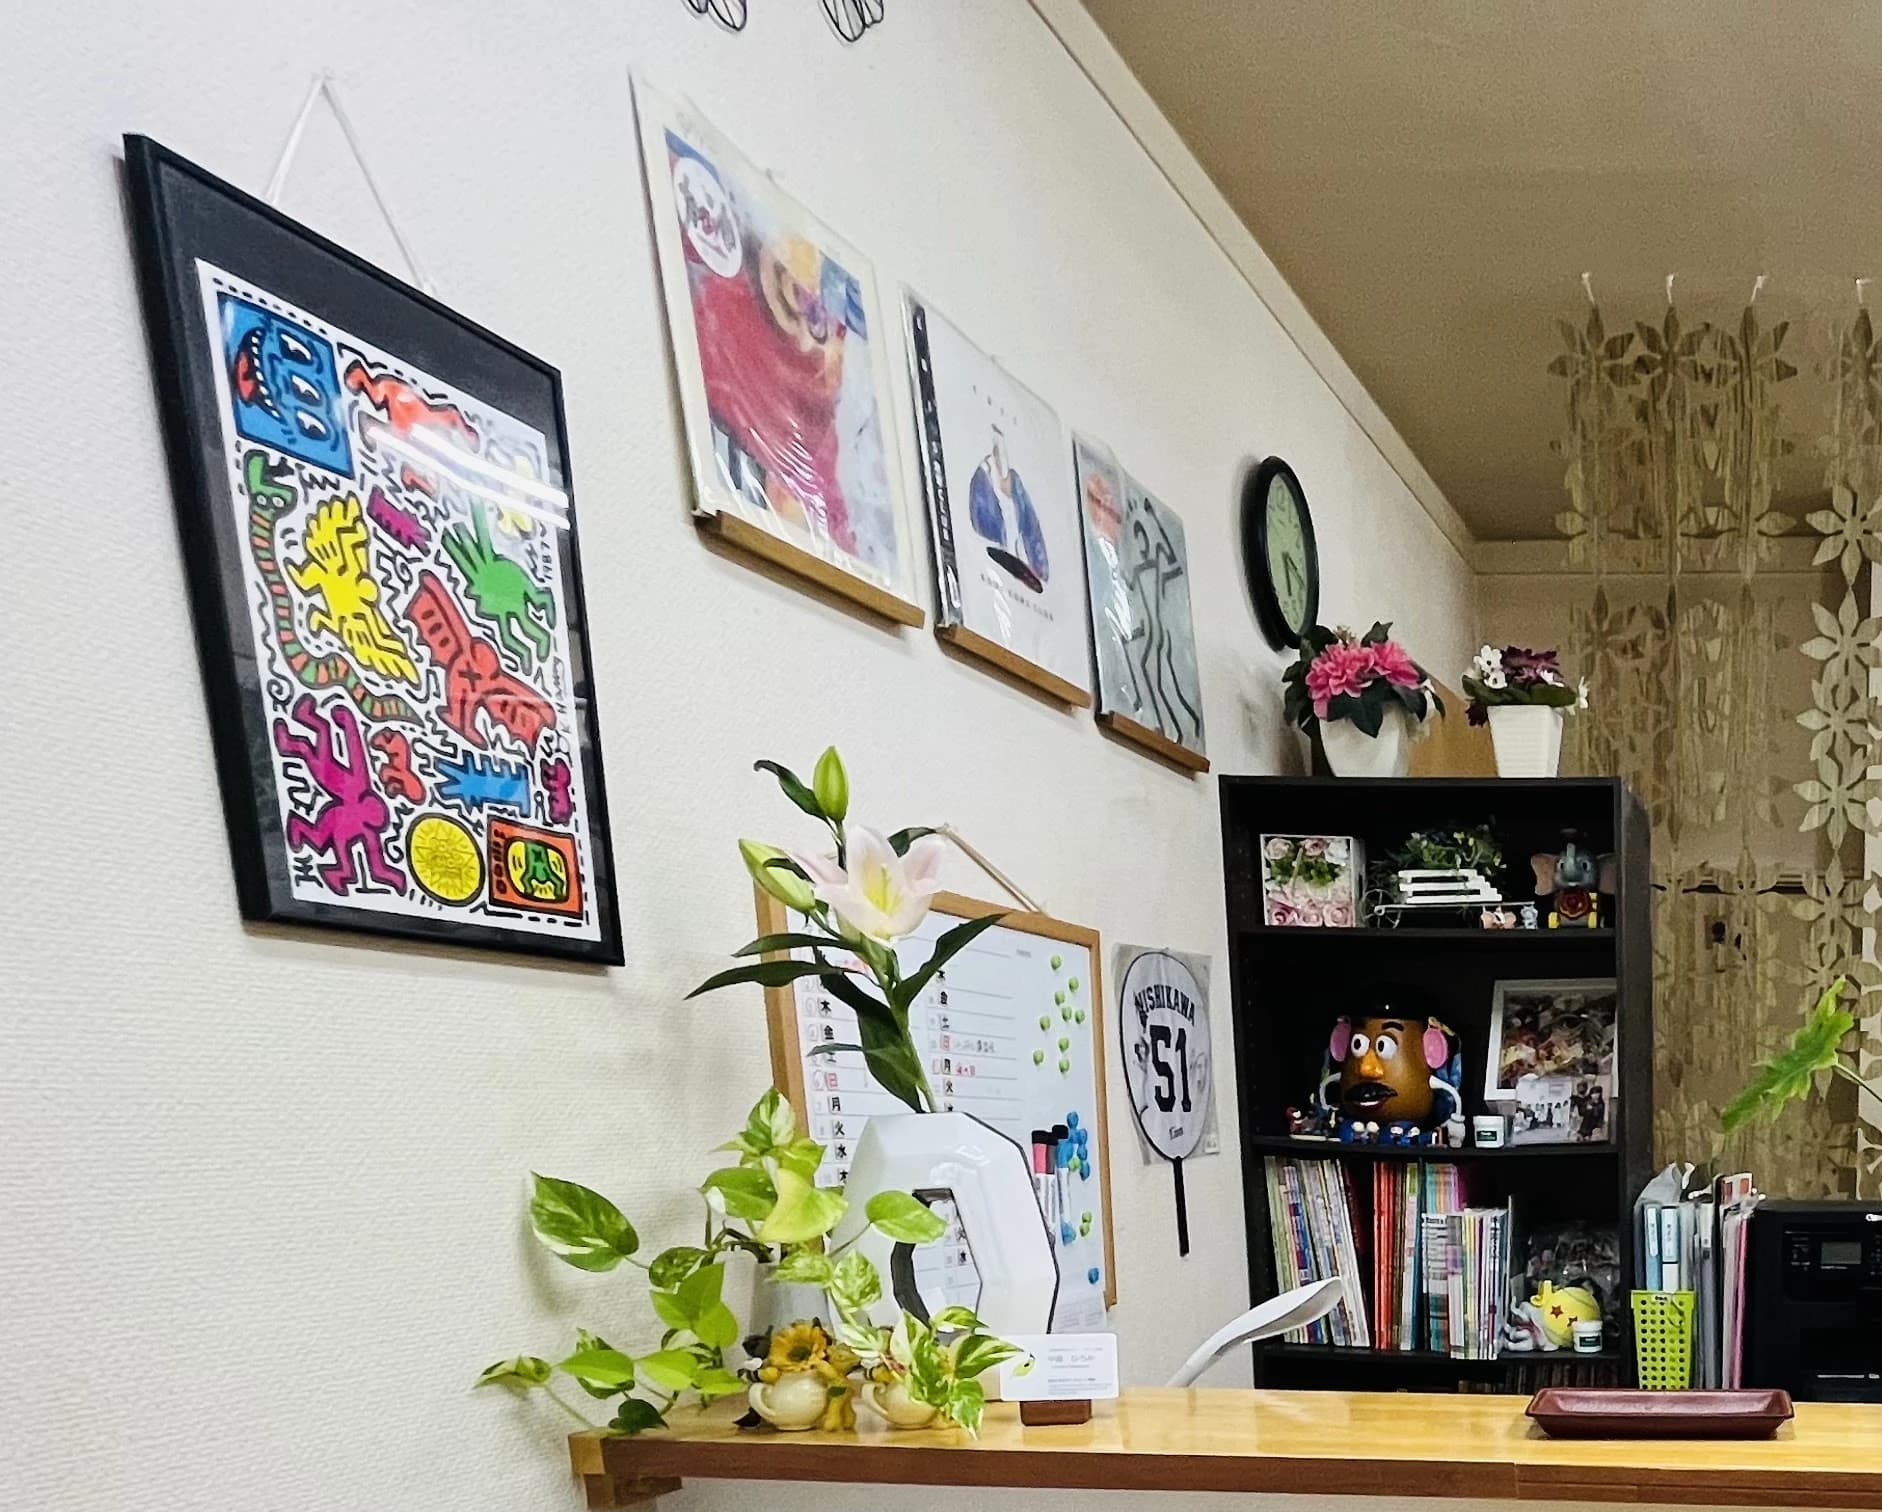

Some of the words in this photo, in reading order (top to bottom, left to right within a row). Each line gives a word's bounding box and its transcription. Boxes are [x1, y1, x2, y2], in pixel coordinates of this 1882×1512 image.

[1134, 984, 1195, 1027] NISHIKAWA
[1150, 1024, 1192, 1113] 51
[831, 1097, 841, 1111] 月
